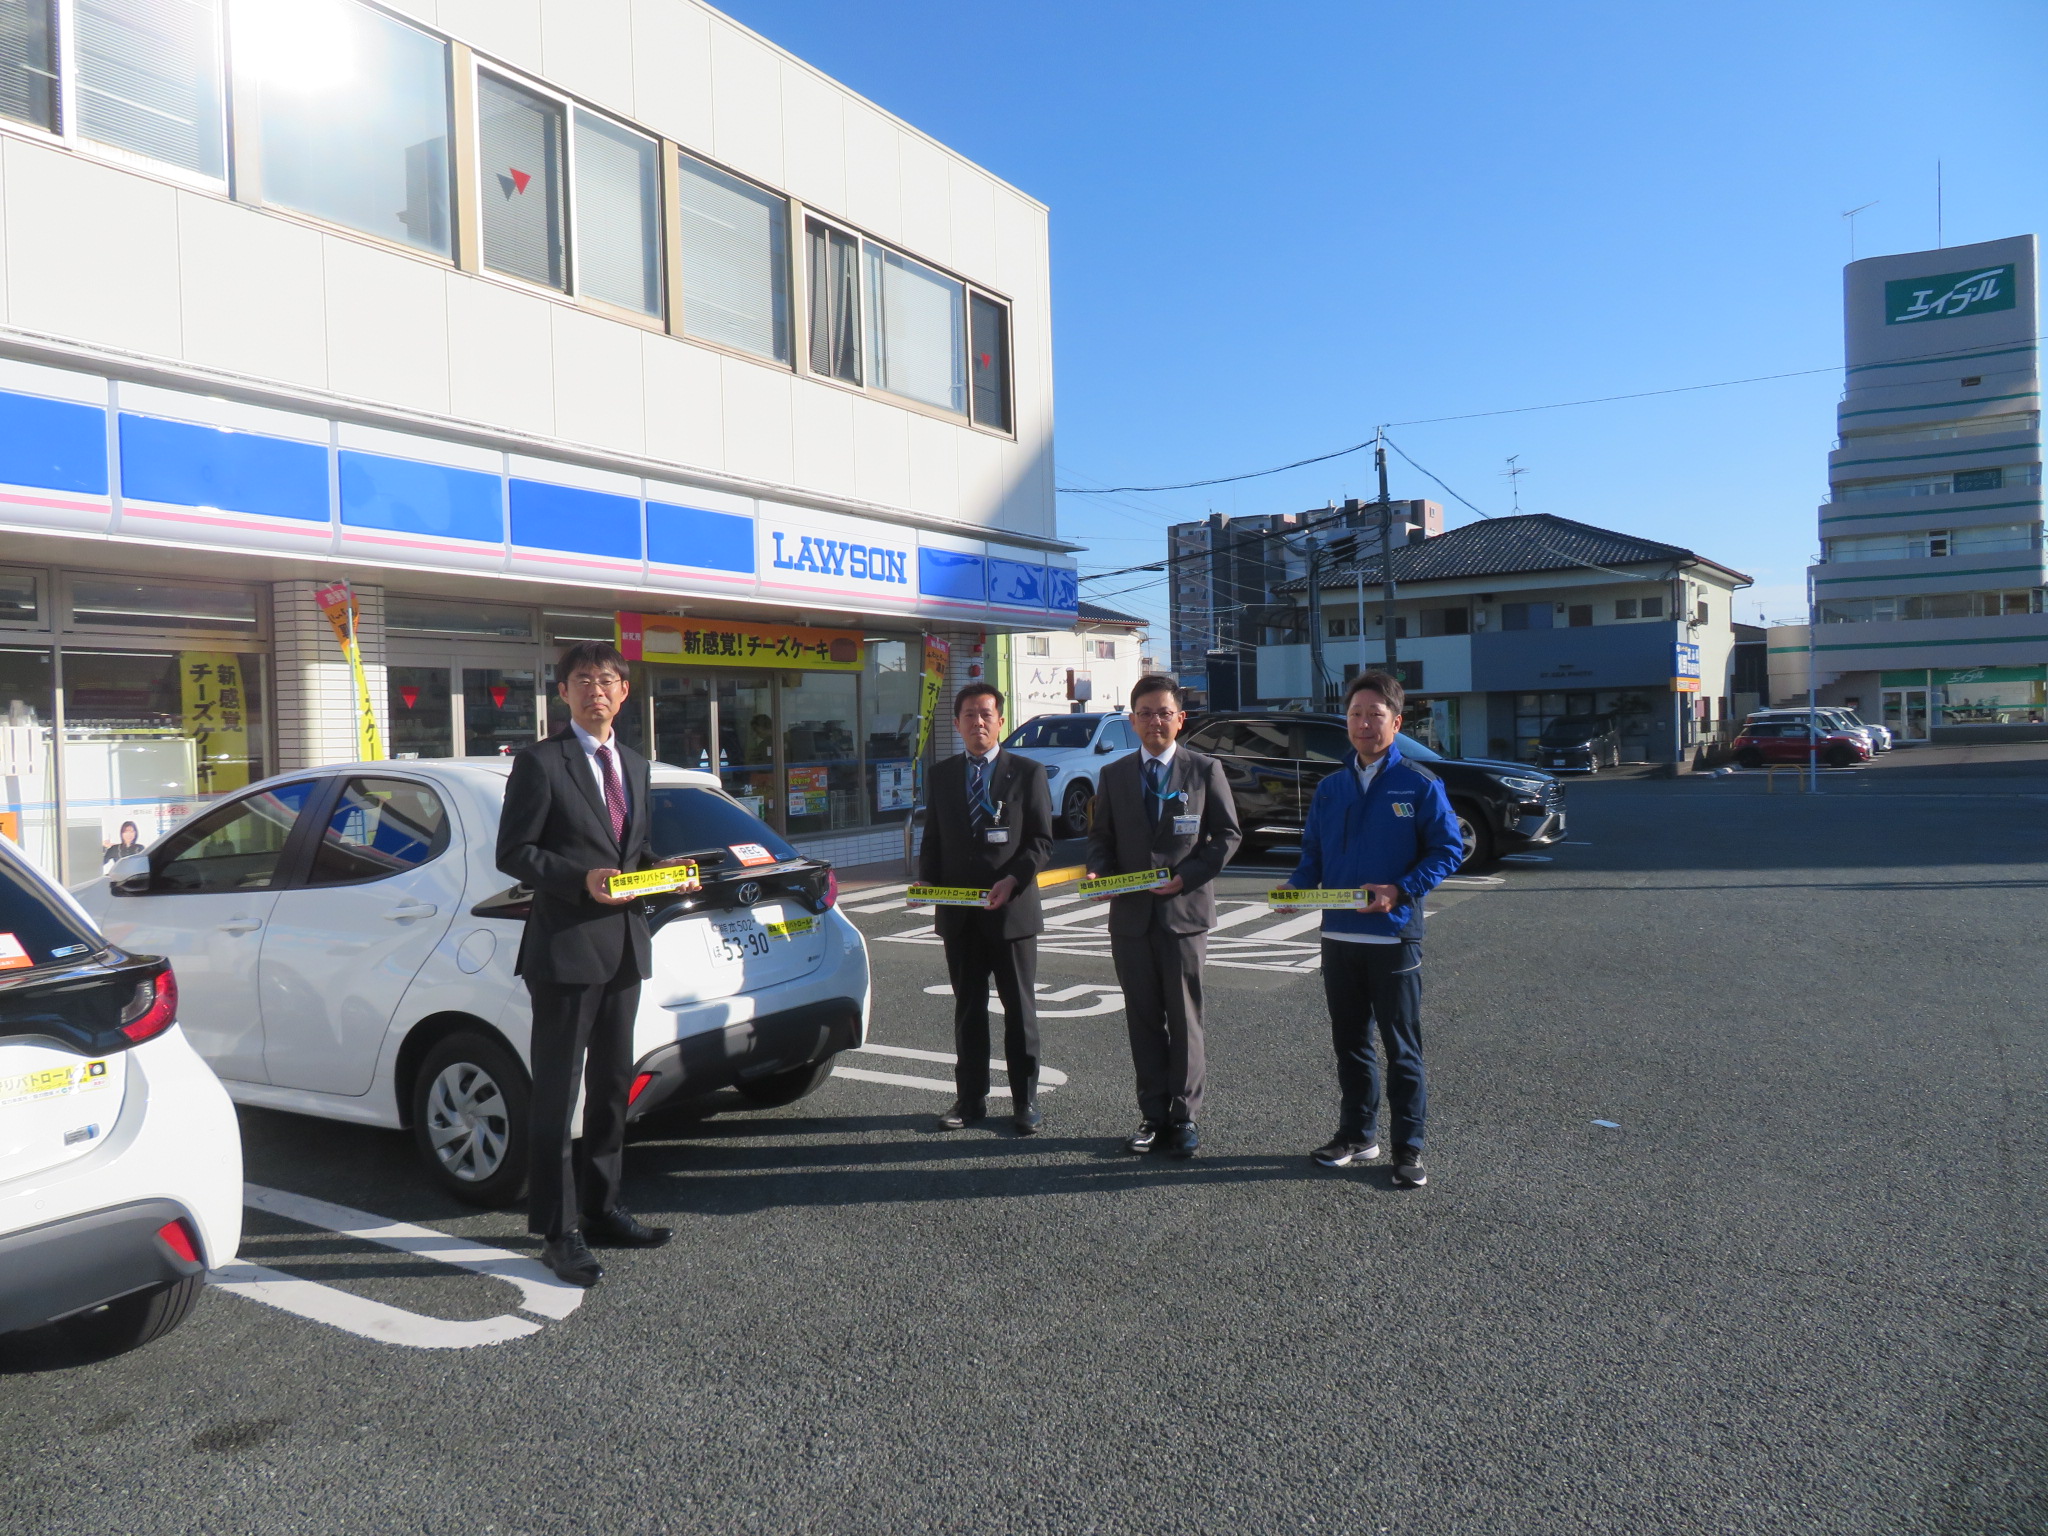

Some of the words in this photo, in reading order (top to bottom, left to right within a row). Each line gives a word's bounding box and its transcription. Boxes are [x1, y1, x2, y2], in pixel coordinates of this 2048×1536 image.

[1895, 268, 2005, 321] エイブル
[772, 531, 907, 584] LAWSON
[189, 663, 217, 784] チーズケーキ
[217, 664, 242, 733] 新感覚
[740, 846, 761, 855] REC
[722, 932, 769, 961] 53-90
